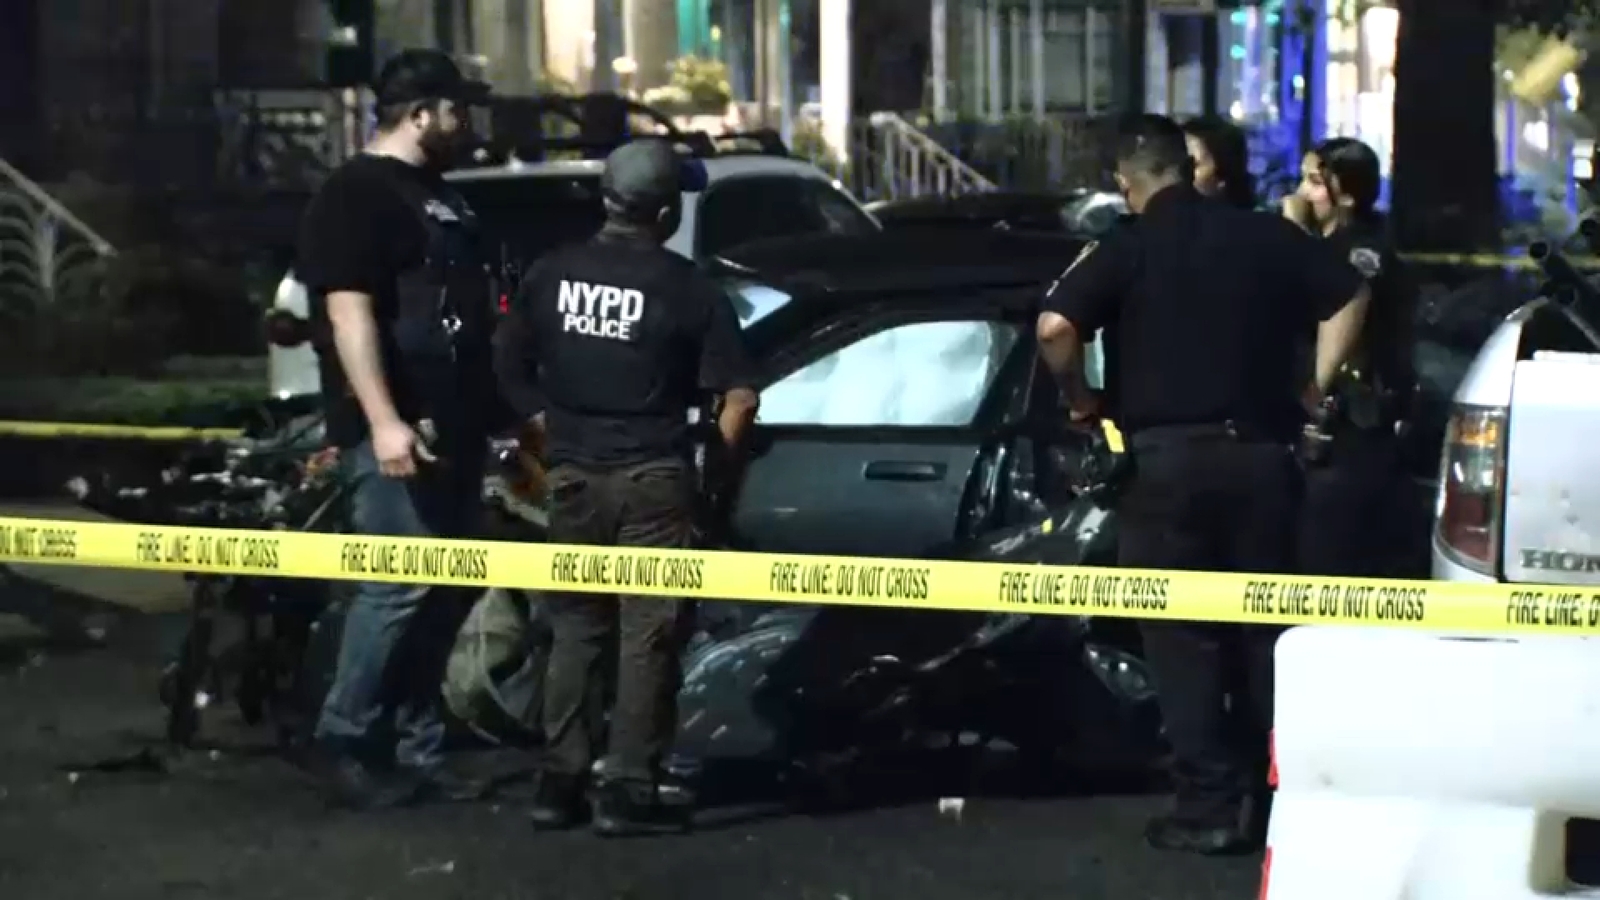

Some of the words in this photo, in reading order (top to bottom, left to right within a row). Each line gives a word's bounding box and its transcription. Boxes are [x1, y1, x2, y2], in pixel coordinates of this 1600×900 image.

[558, 280, 645, 322] NYPD
[563, 313, 631, 340] POLICE
[137, 532, 162, 562] FIRE
[196, 535, 213, 565] DO
[215, 537, 239, 567] NOT
[241, 538, 279, 568] CROSS
[341, 542, 368, 572] FIRE
[370, 544, 399, 573] LINE:
[402, 545, 419, 575] DO
[422, 547, 447, 577] NOT
[448, 548, 488, 579] CROSS
[551, 552, 580, 582] FIRE
[582, 554, 612, 584] LINE:
[615, 555, 633, 585] DO
[635, 556, 661, 587] NOT
[662, 557, 705, 589] CROSS
[770, 562, 799, 593] FIRE
[801, 564, 833, 595] LINE:
[836, 564, 856, 596] DO
[858, 566, 885, 597] NOT
[886, 567, 930, 599] CROSS
[999, 571, 1031, 603] FIRE
[1032, 573, 1066, 605] LINE:
[1069, 574, 1091, 606] DO
[1092, 575, 1122, 608] NOT
[1122, 577, 1170, 610] CROSS
[1242, 581, 1277, 613] FIRE
[1278, 582, 1315, 616] LINE:
[1317, 584, 1340, 617] DO
[1342, 585, 1375, 619] NOT
[1375, 586, 1427, 621] CROSS
[1507, 591, 1544, 625] FIRE
[1544, 592, 1585, 627] LINE:
